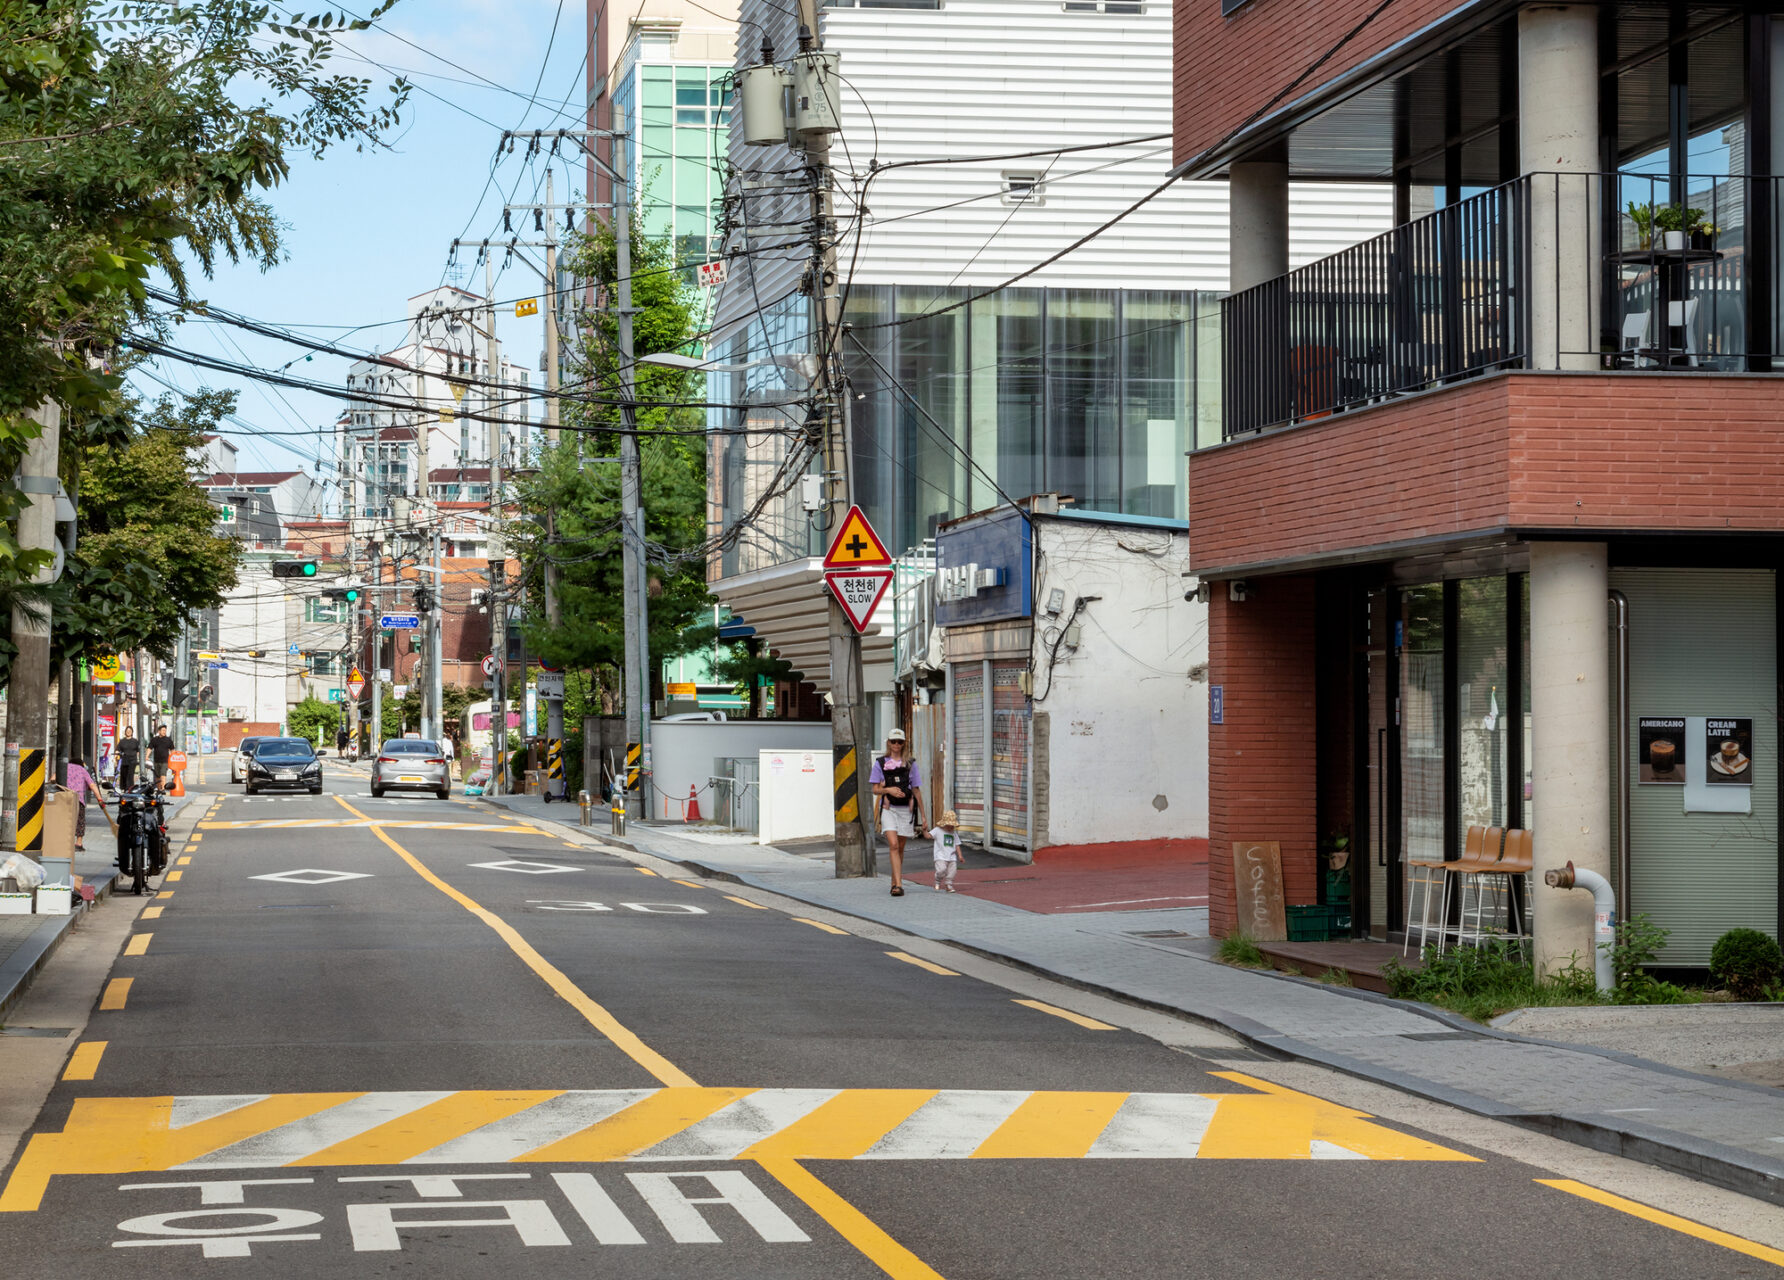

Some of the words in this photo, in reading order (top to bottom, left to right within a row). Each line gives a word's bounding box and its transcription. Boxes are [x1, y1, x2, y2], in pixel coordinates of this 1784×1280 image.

[843, 578, 876, 593] 천천히
[848, 594, 872, 604] SLOW
[1213, 697, 1220, 713] 20
[1640, 720, 1684, 728] AMERICANO
[1707, 721, 1737, 729] CREAM
[1707, 729, 1731, 737] LATTE
[1246, 846, 1272, 936] Coffee
[525, 900, 709, 914] 30
[111, 1170, 813, 1259] 비보호
